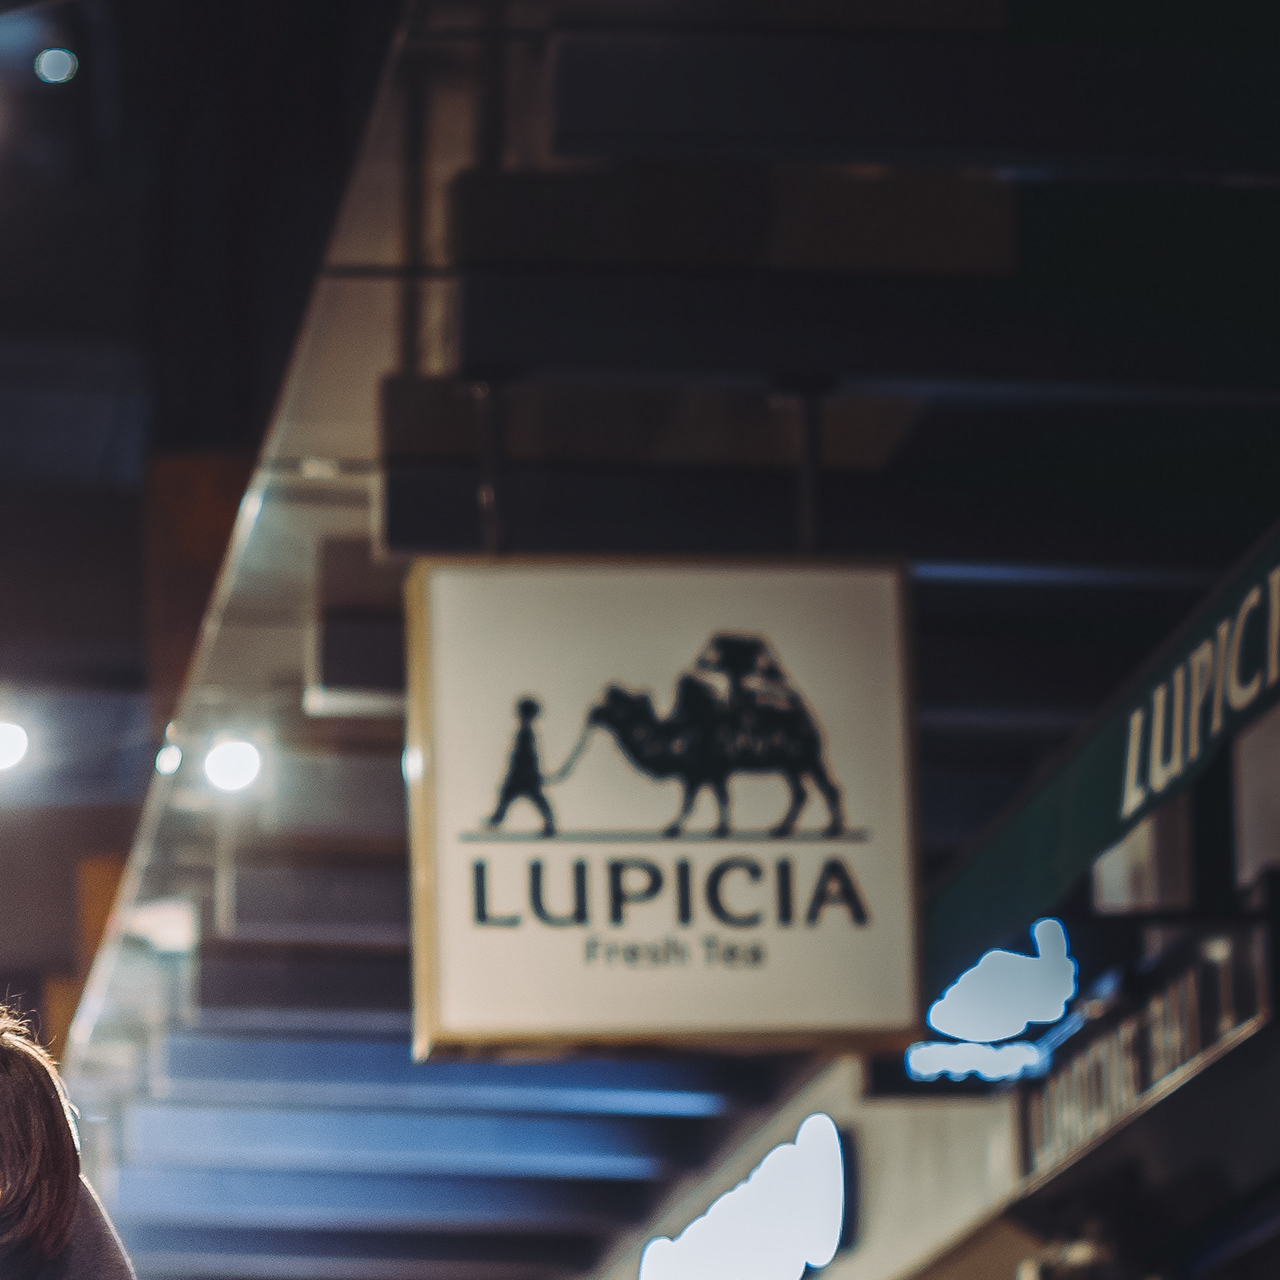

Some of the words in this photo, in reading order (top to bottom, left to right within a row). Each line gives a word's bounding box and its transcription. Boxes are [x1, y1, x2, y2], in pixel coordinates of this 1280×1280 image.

[472, 856, 871, 928] LUPICIA
[584, 935, 689, 968] Fresh
[703, 936, 766, 967] Tea
